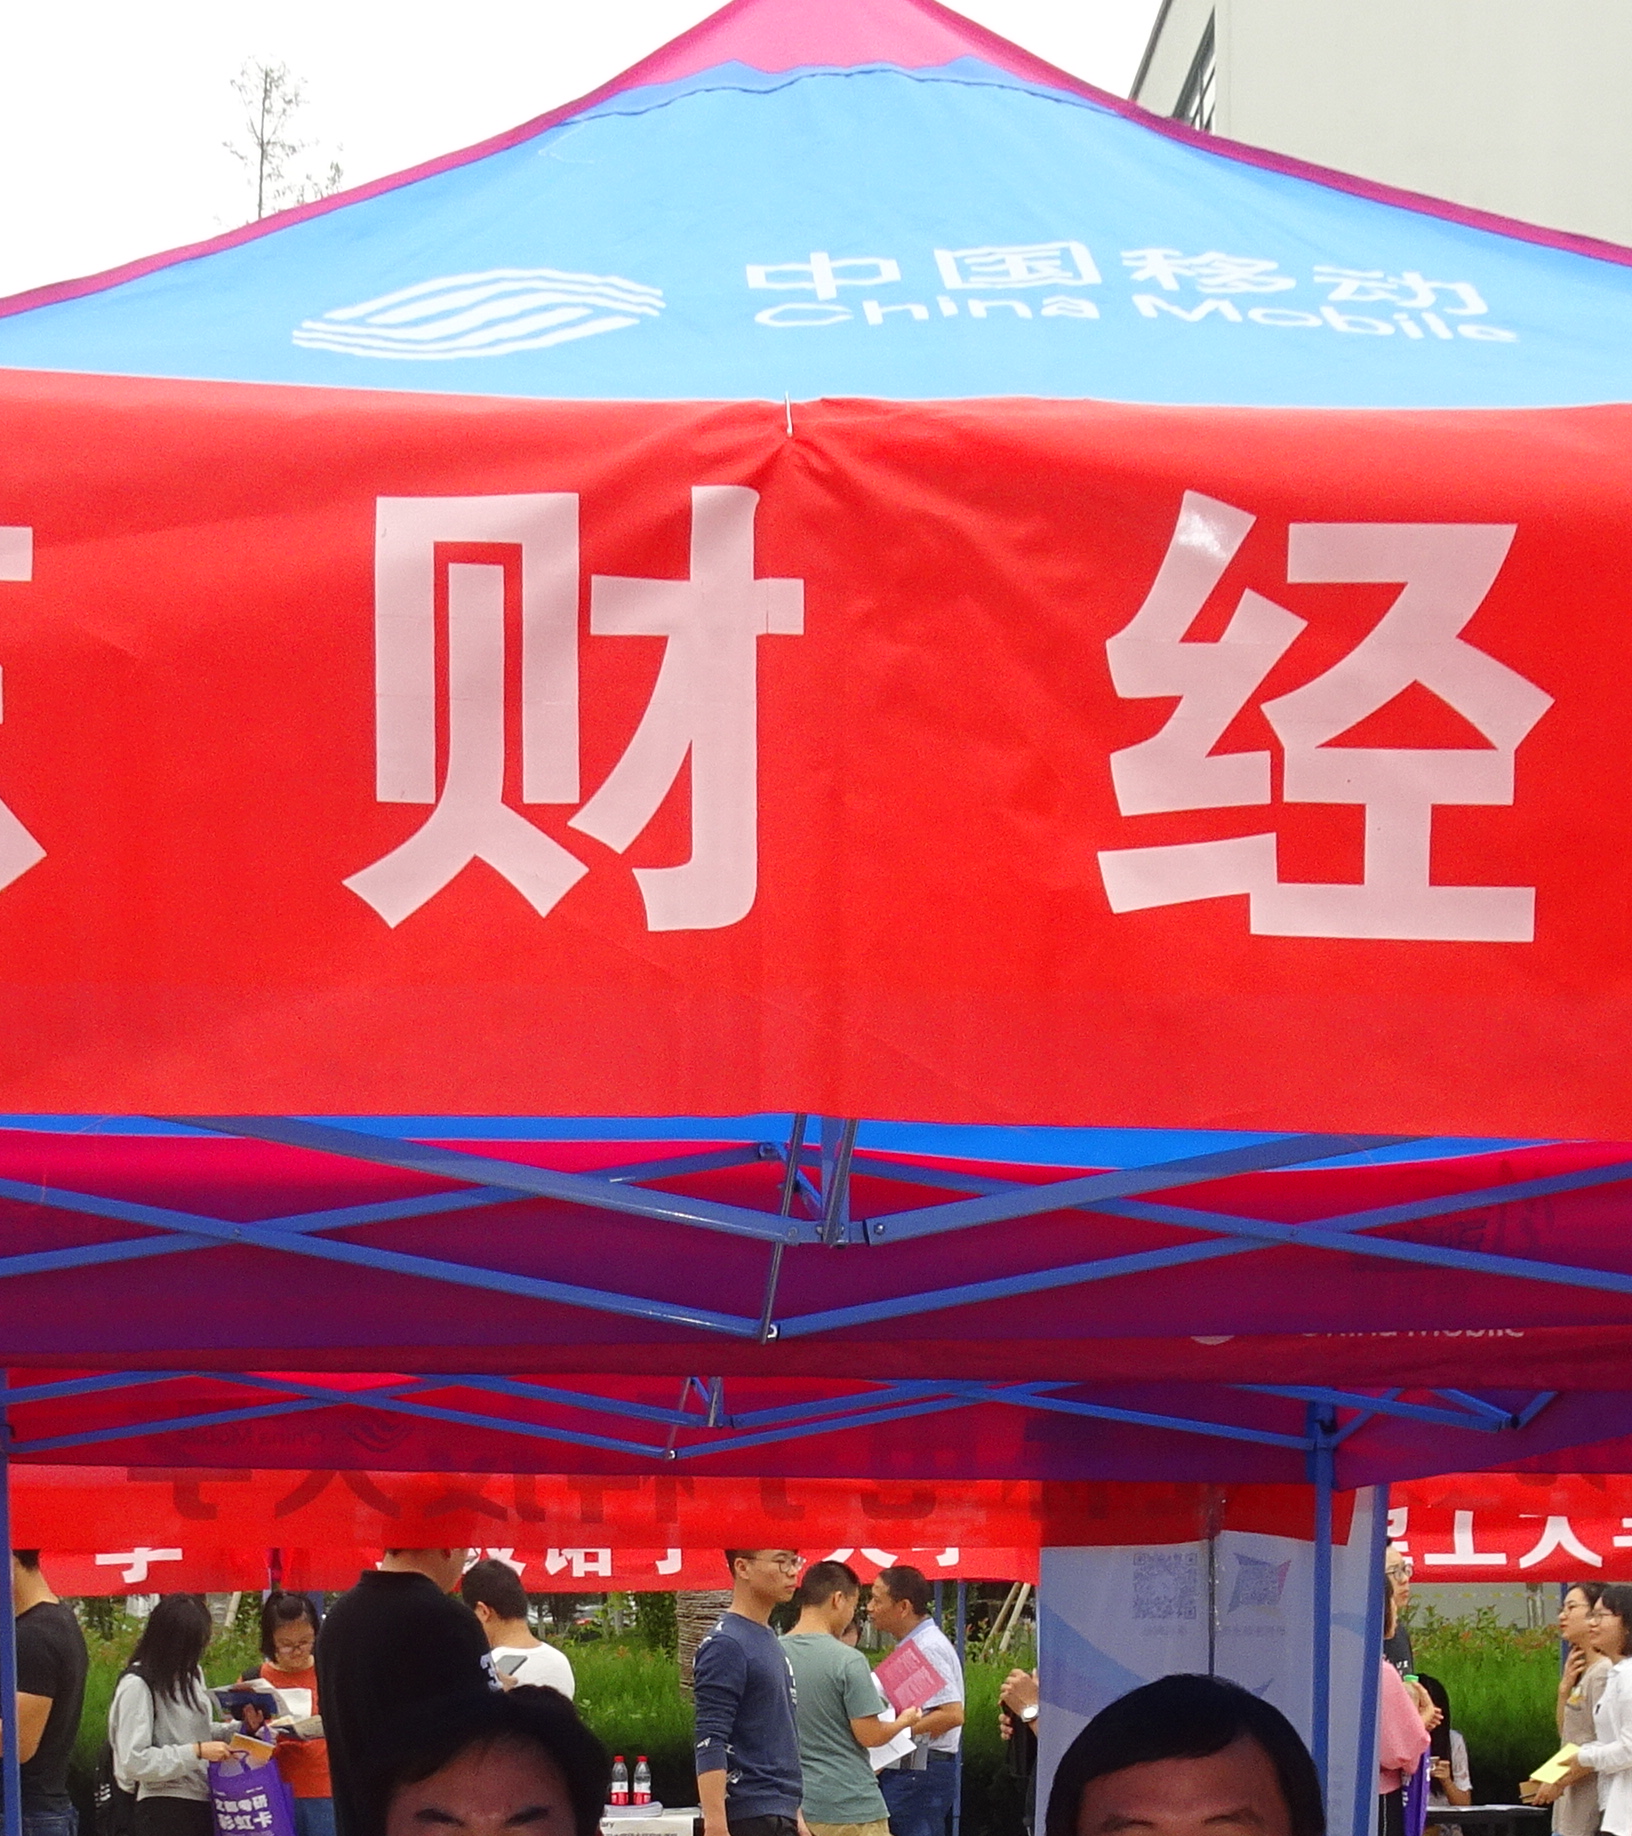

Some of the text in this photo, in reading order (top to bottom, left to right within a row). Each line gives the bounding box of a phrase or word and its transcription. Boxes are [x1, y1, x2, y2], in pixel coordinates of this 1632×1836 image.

[744, 240, 1492, 318] 中国移动
[752, 284, 1522, 344] China Mobile
